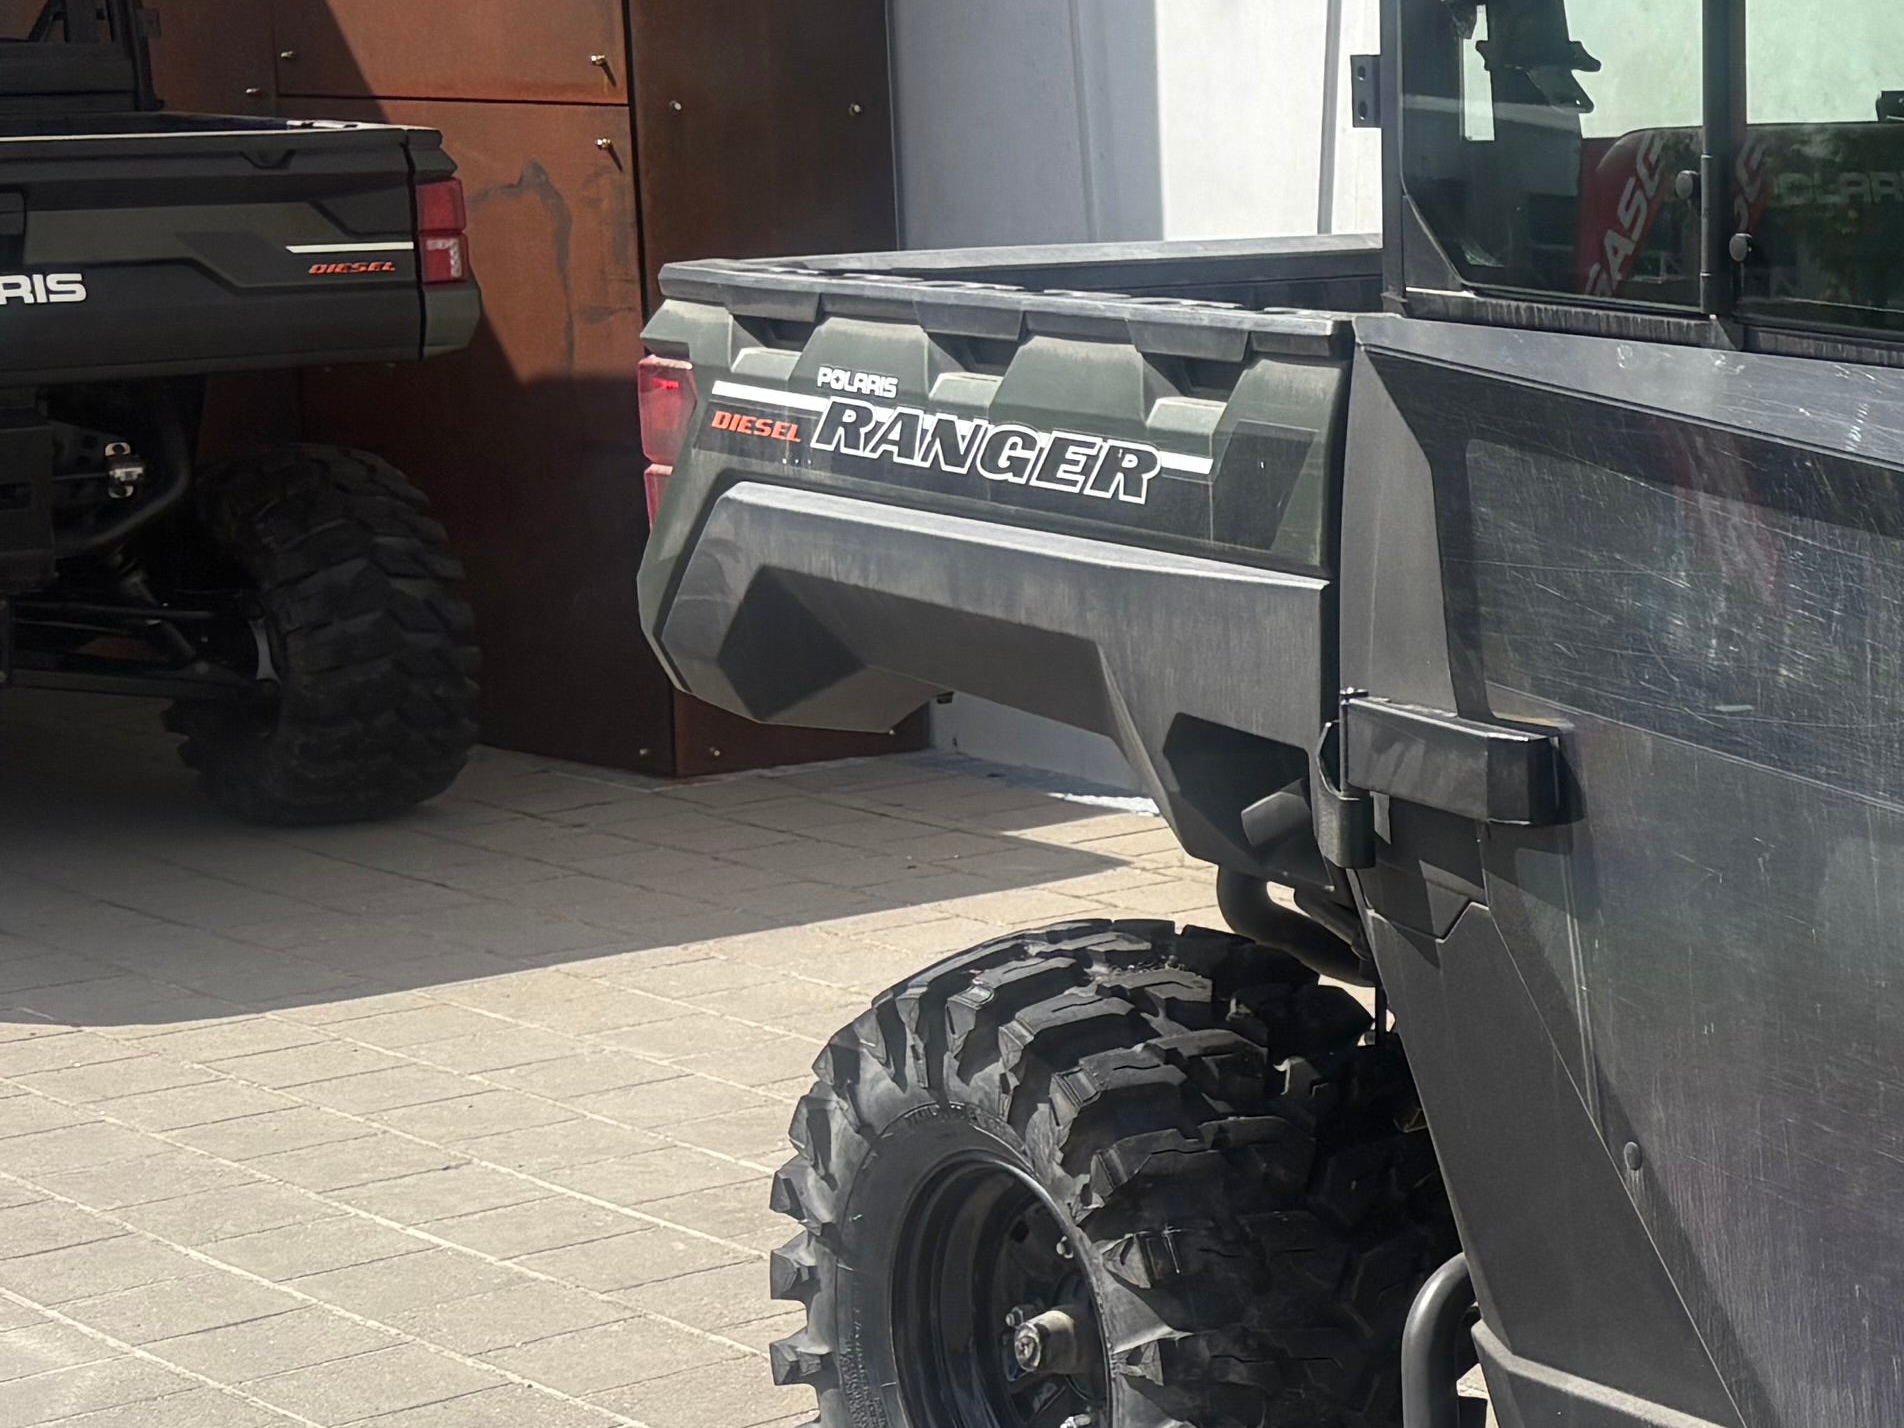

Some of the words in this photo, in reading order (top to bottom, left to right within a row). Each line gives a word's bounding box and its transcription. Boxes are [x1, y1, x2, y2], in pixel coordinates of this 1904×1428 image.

[309, 260, 396, 276] DIESEL
[816, 366, 898, 398] POLARIS
[710, 410, 802, 444] DIESEL
[811, 395, 1163, 505] RANGER
